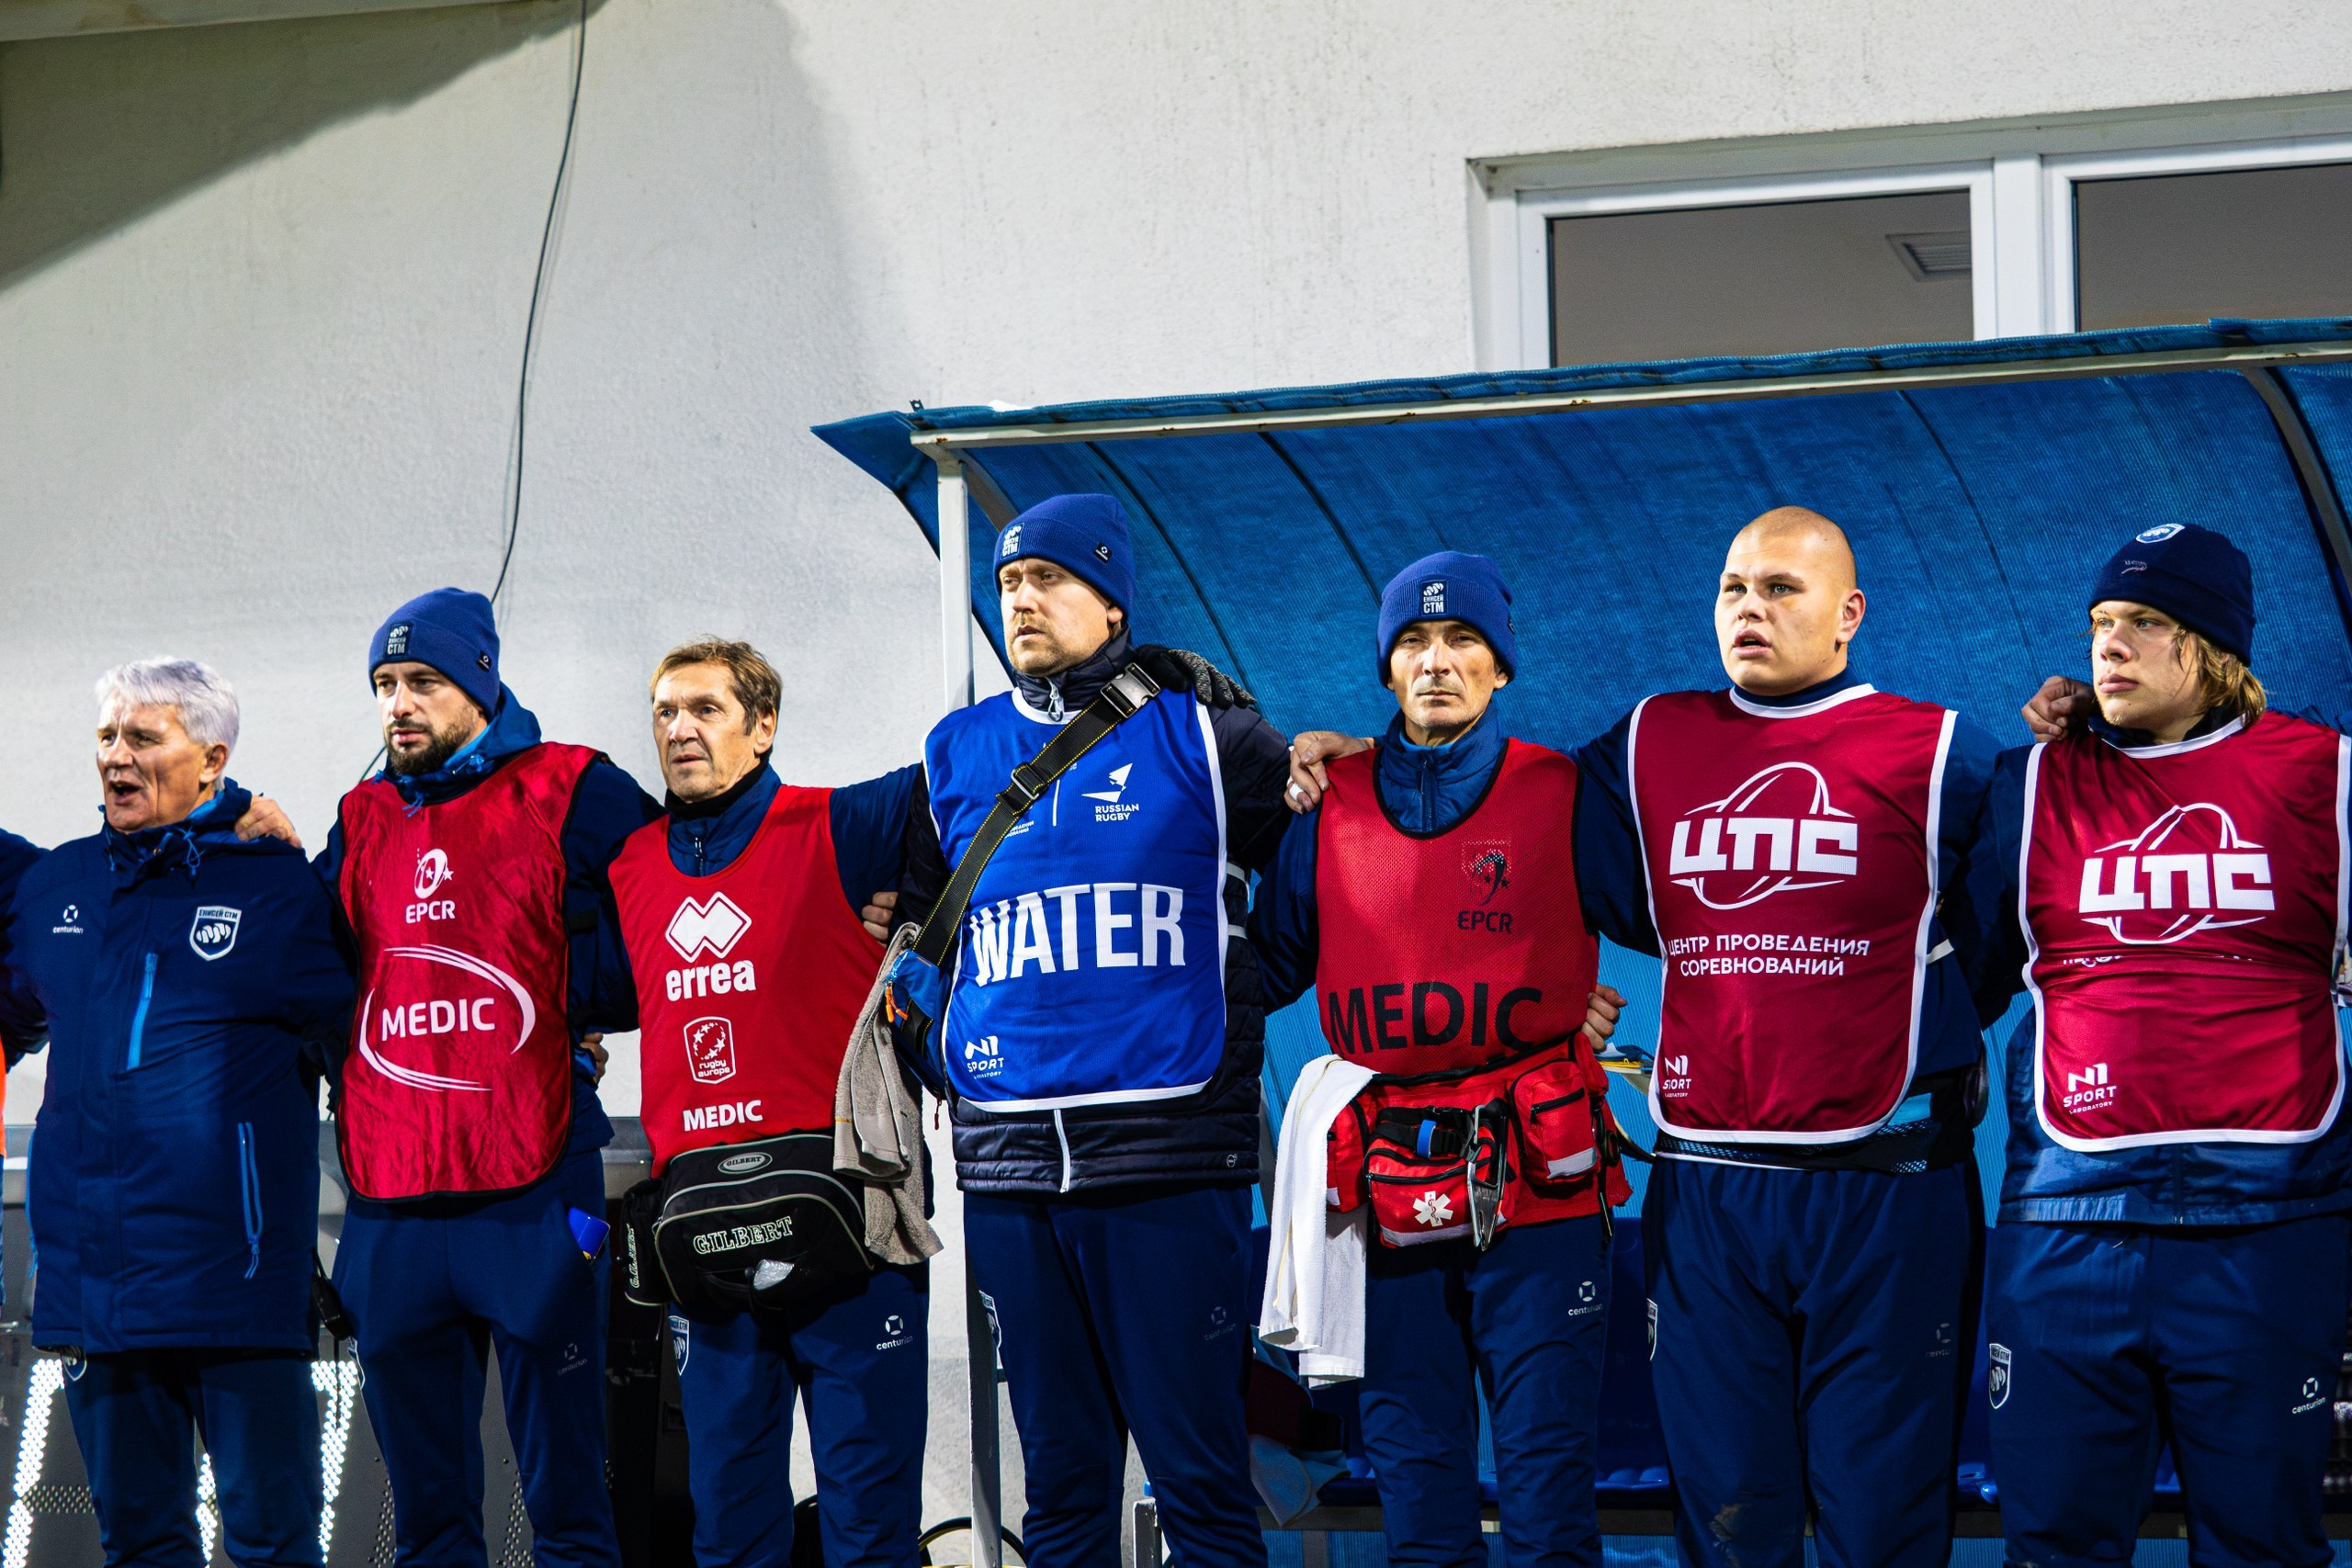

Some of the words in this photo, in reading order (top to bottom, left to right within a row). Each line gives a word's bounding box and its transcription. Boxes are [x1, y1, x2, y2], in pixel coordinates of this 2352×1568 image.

[1423, 602, 1444, 614] СТМ
[387, 643, 405, 655] СТМ
[1095, 803, 1139, 814] RUSSIAN
[1095, 812, 1130, 822] RUGBY
[1669, 818, 1858, 875] ЦПС
[2078, 853, 2276, 913] ЦПС
[405, 900, 456, 924] EPCR
[1457, 909, 1513, 934] EPCR
[52, 926, 84, 934] centurion
[969, 882, 1186, 987] WATER
[1668, 936, 1710, 956] ЦЕНТР
[1716, 934, 1871, 956] ПРОВЕДЕНИЯ
[1680, 956, 1845, 976] СОРЕВНОВАНИЙ
[381, 998, 496, 1042] MEDIC
[1328, 981, 1543, 1055] MEDIC
[698, 1066, 730, 1077] europe
[699, 1059, 727, 1069] rugby
[967, 1057, 1004, 1073] SPORT
[2063, 1086, 2117, 1108] SPORT
[683, 1100, 763, 1132] MEDIC
[2069, 1101, 2113, 1114] LABORATORY
[726, 1156, 763, 1167] GILBERT
[693, 1215, 794, 1255] GILBERT
[2291, 1396, 2326, 1415] centurion
